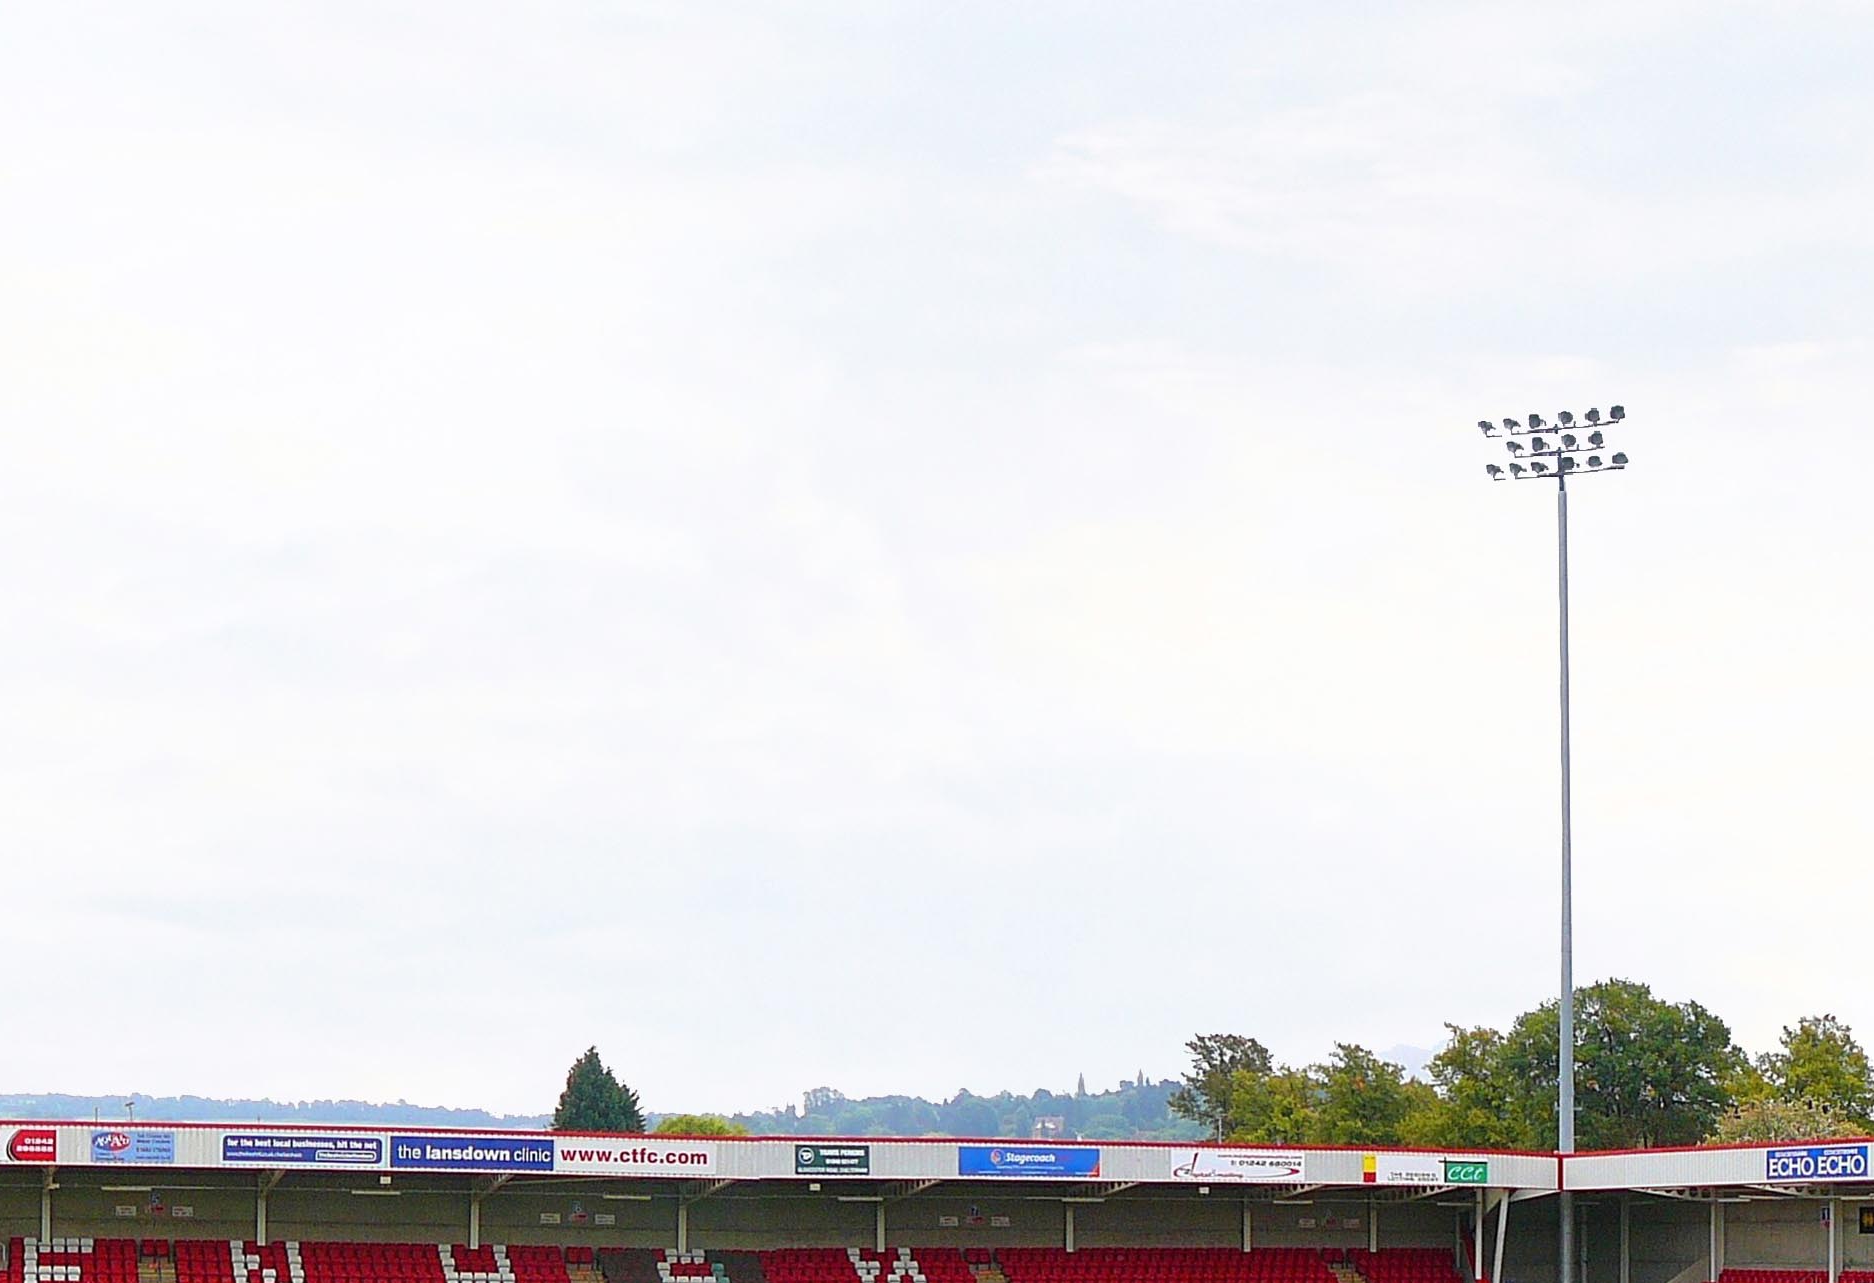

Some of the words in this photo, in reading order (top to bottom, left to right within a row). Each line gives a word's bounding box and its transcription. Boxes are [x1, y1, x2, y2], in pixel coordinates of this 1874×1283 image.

[227, 1138, 238, 1147] for
[240, 1138, 252, 1147] the
[254, 1138, 271, 1148] best
[273, 1139, 291, 1148] local
[349, 1140, 362, 1149] the
[364, 1141, 377, 1149] net
[398, 1143, 421, 1159] the
[426, 1144, 510, 1161] lansdown
[514, 1147, 551, 1162] clinic
[560, 1148, 708, 1164] www.ctfc.com
[1005, 1152, 1055, 1164] Stagecoach
[1769, 1157, 1814, 1176] ECHO
[1817, 1155, 1865, 1175] ECHO
